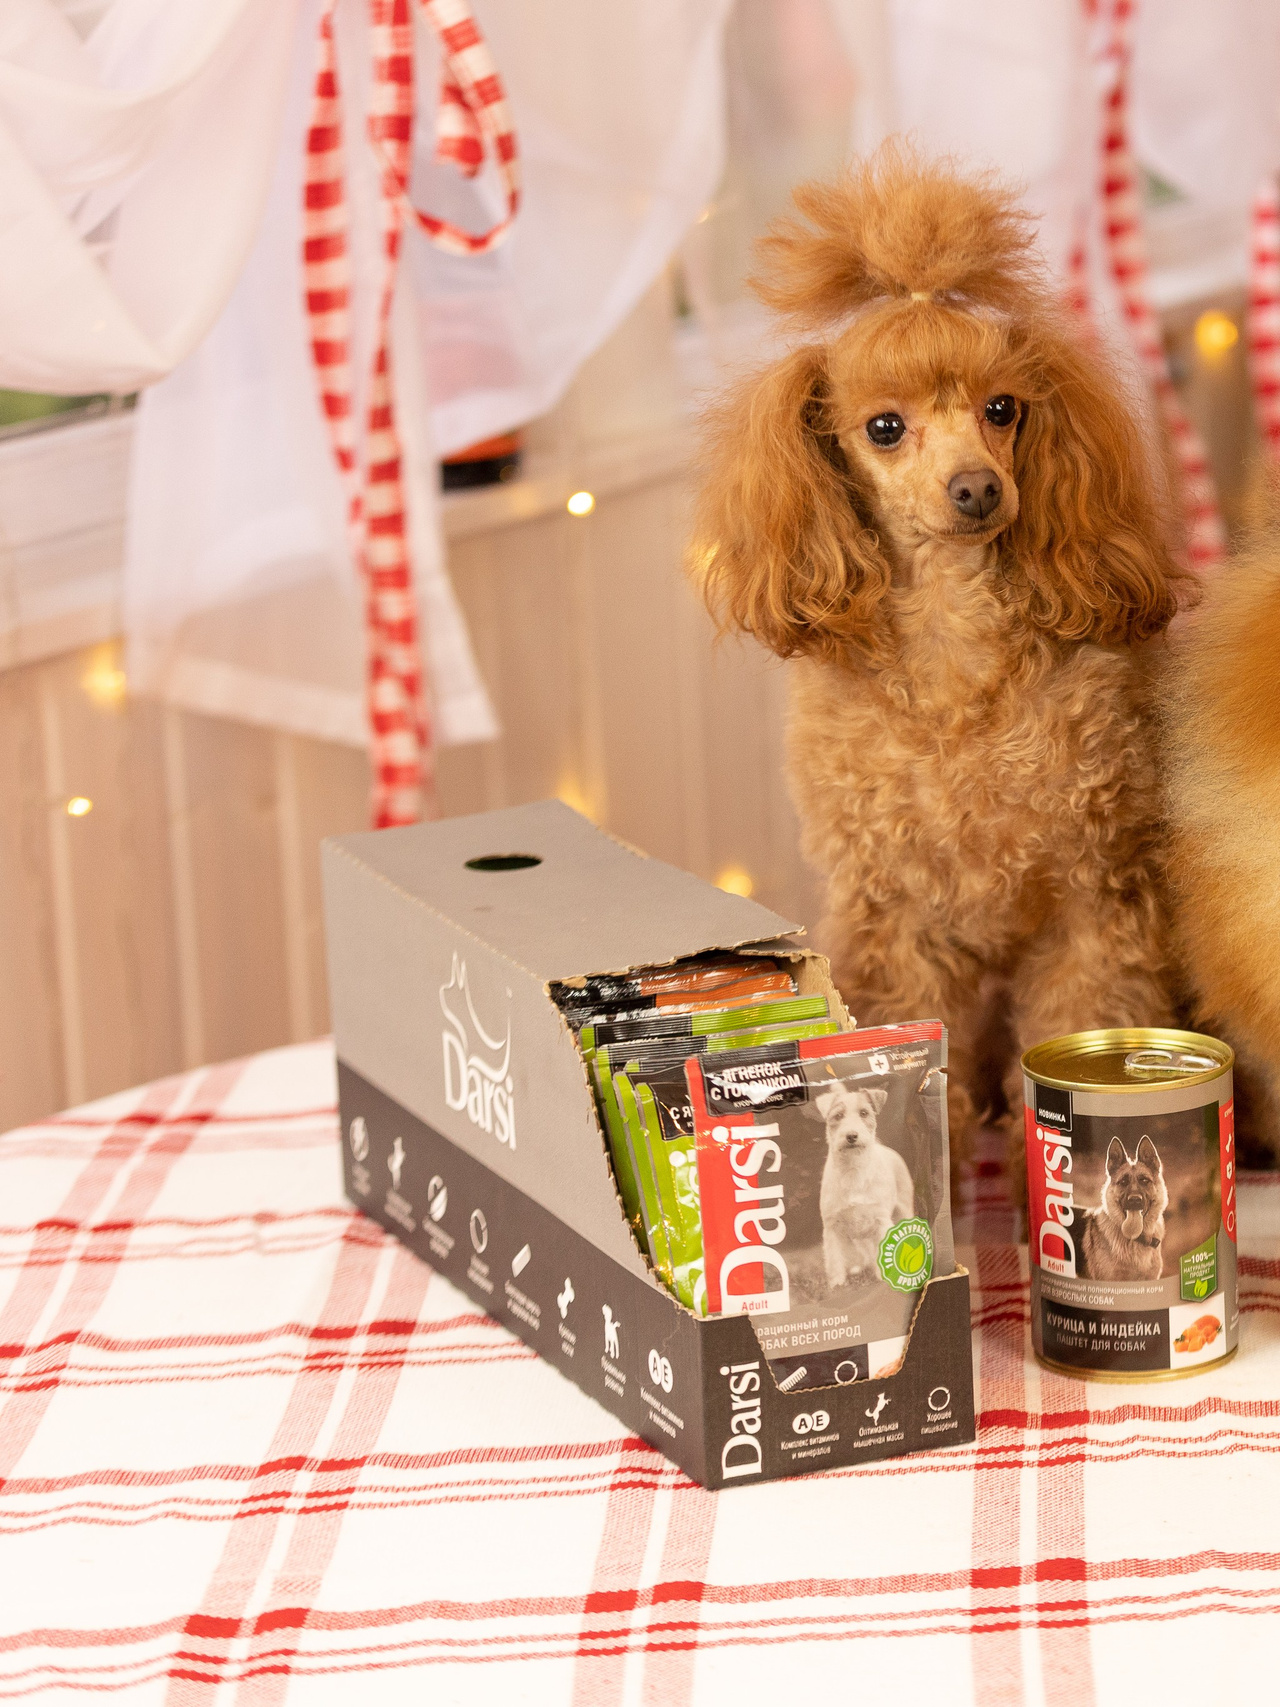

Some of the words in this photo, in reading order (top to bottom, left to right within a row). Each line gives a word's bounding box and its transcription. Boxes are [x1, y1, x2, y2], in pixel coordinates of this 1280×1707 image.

[442, 1029, 516, 1150] Darsi
[710, 1087, 722, 1100] С
[1038, 1108, 1066, 1123] НОВИНКА
[1036, 1127, 1077, 1279] Darsi
[711, 1122, 790, 1315] Darsi
[884, 1243, 895, 1269] 100%
[1191, 1251, 1208, 1264] 100%
[1047, 1260, 1065, 1273] Adult
[897, 1268, 928, 1287] ПРОДУКТ
[1146, 1285, 1164, 1294] КОРМ
[741, 1300, 768, 1311] Adult
[1088, 1295, 1115, 1306] СОБАК
[822, 1315, 849, 1327] корм
[1046, 1312, 1085, 1334] КУРИЦА
[1088, 1321, 1097, 1334] И
[1100, 1321, 1161, 1339] ИНДЕЙКА
[791, 1332, 820, 1347] ВСЕХ
[823, 1325, 861, 1341] ПОРОД
[1056, 1333, 1088, 1349] ПАШТЕТ
[1090, 1338, 1111, 1351] ДЛЯ
[1113, 1340, 1146, 1352] СОБАК
[720, 1361, 762, 1480] Darsi
